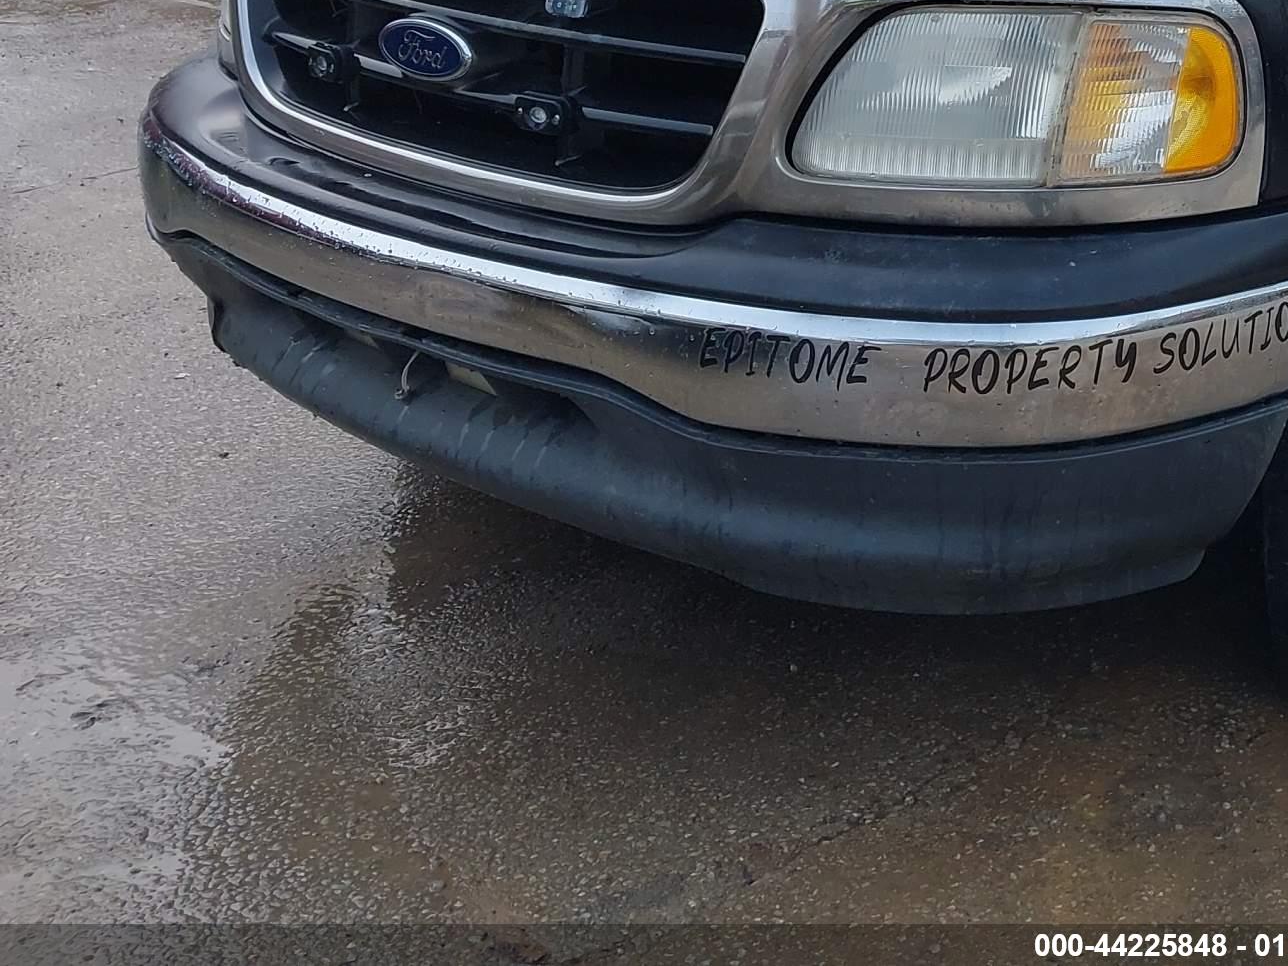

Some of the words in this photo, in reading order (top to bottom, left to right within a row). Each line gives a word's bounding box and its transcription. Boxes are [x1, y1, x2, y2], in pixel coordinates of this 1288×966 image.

[398, 28, 448, 70] Ford
[699, 326, 885, 393] EPITOME
[922, 336, 1139, 395] PROPERTY
